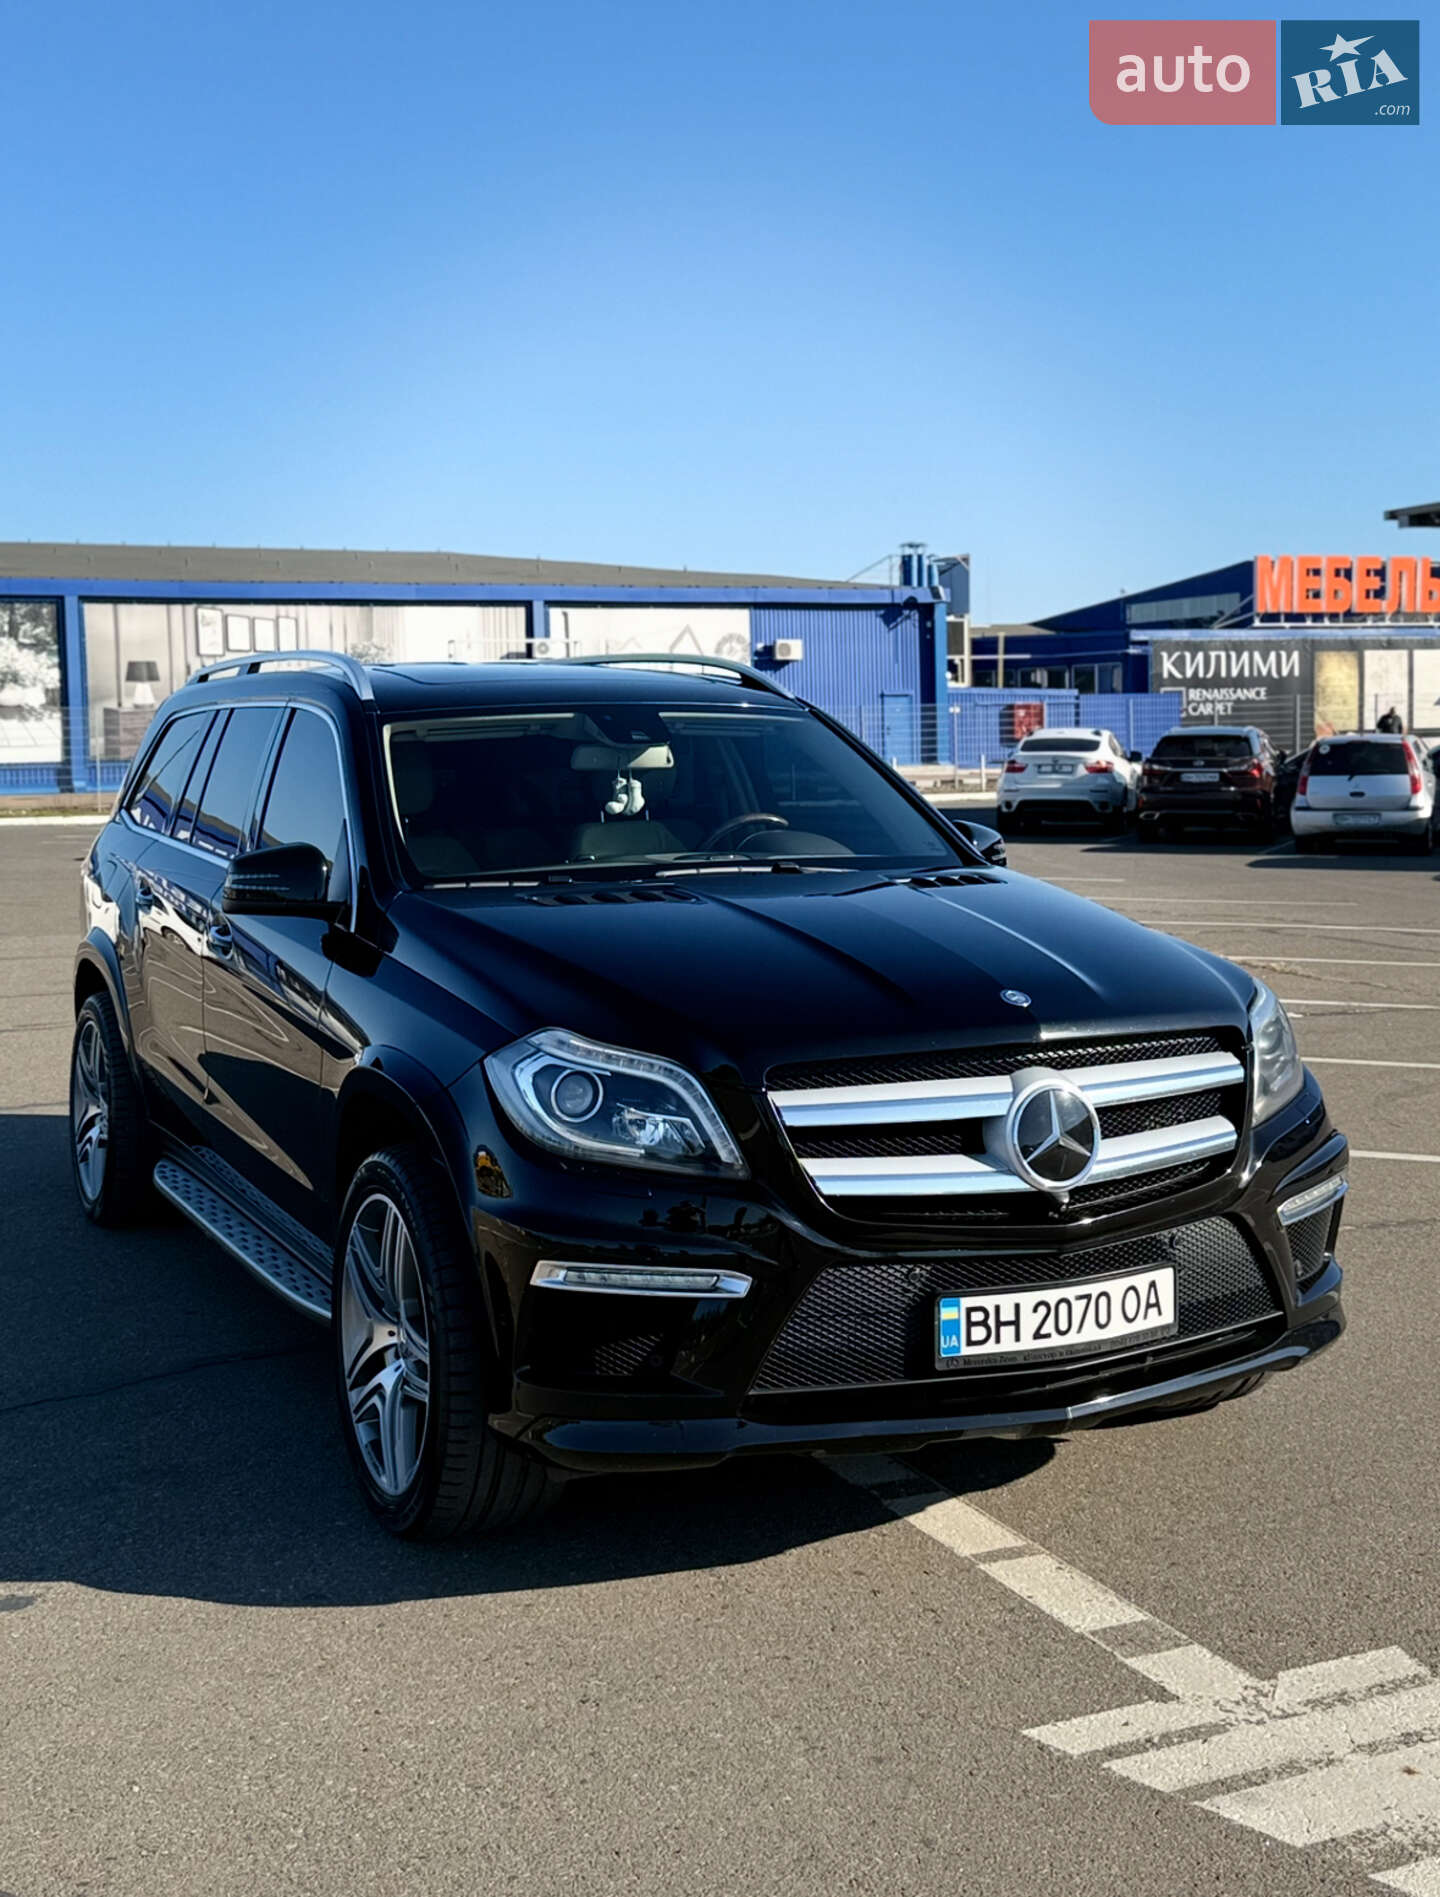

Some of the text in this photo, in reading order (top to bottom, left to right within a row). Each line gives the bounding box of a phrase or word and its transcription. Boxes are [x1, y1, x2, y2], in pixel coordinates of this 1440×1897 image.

[1254, 555, 1440, 614] МЕБЕЛЬ
[1160, 650, 1299, 679] КИЛИМИ
[1188, 687, 1267, 701] RENAISSANCE
[1032, 1291, 1111, 1340] 2070
[941, 1335, 959, 1348] UA
